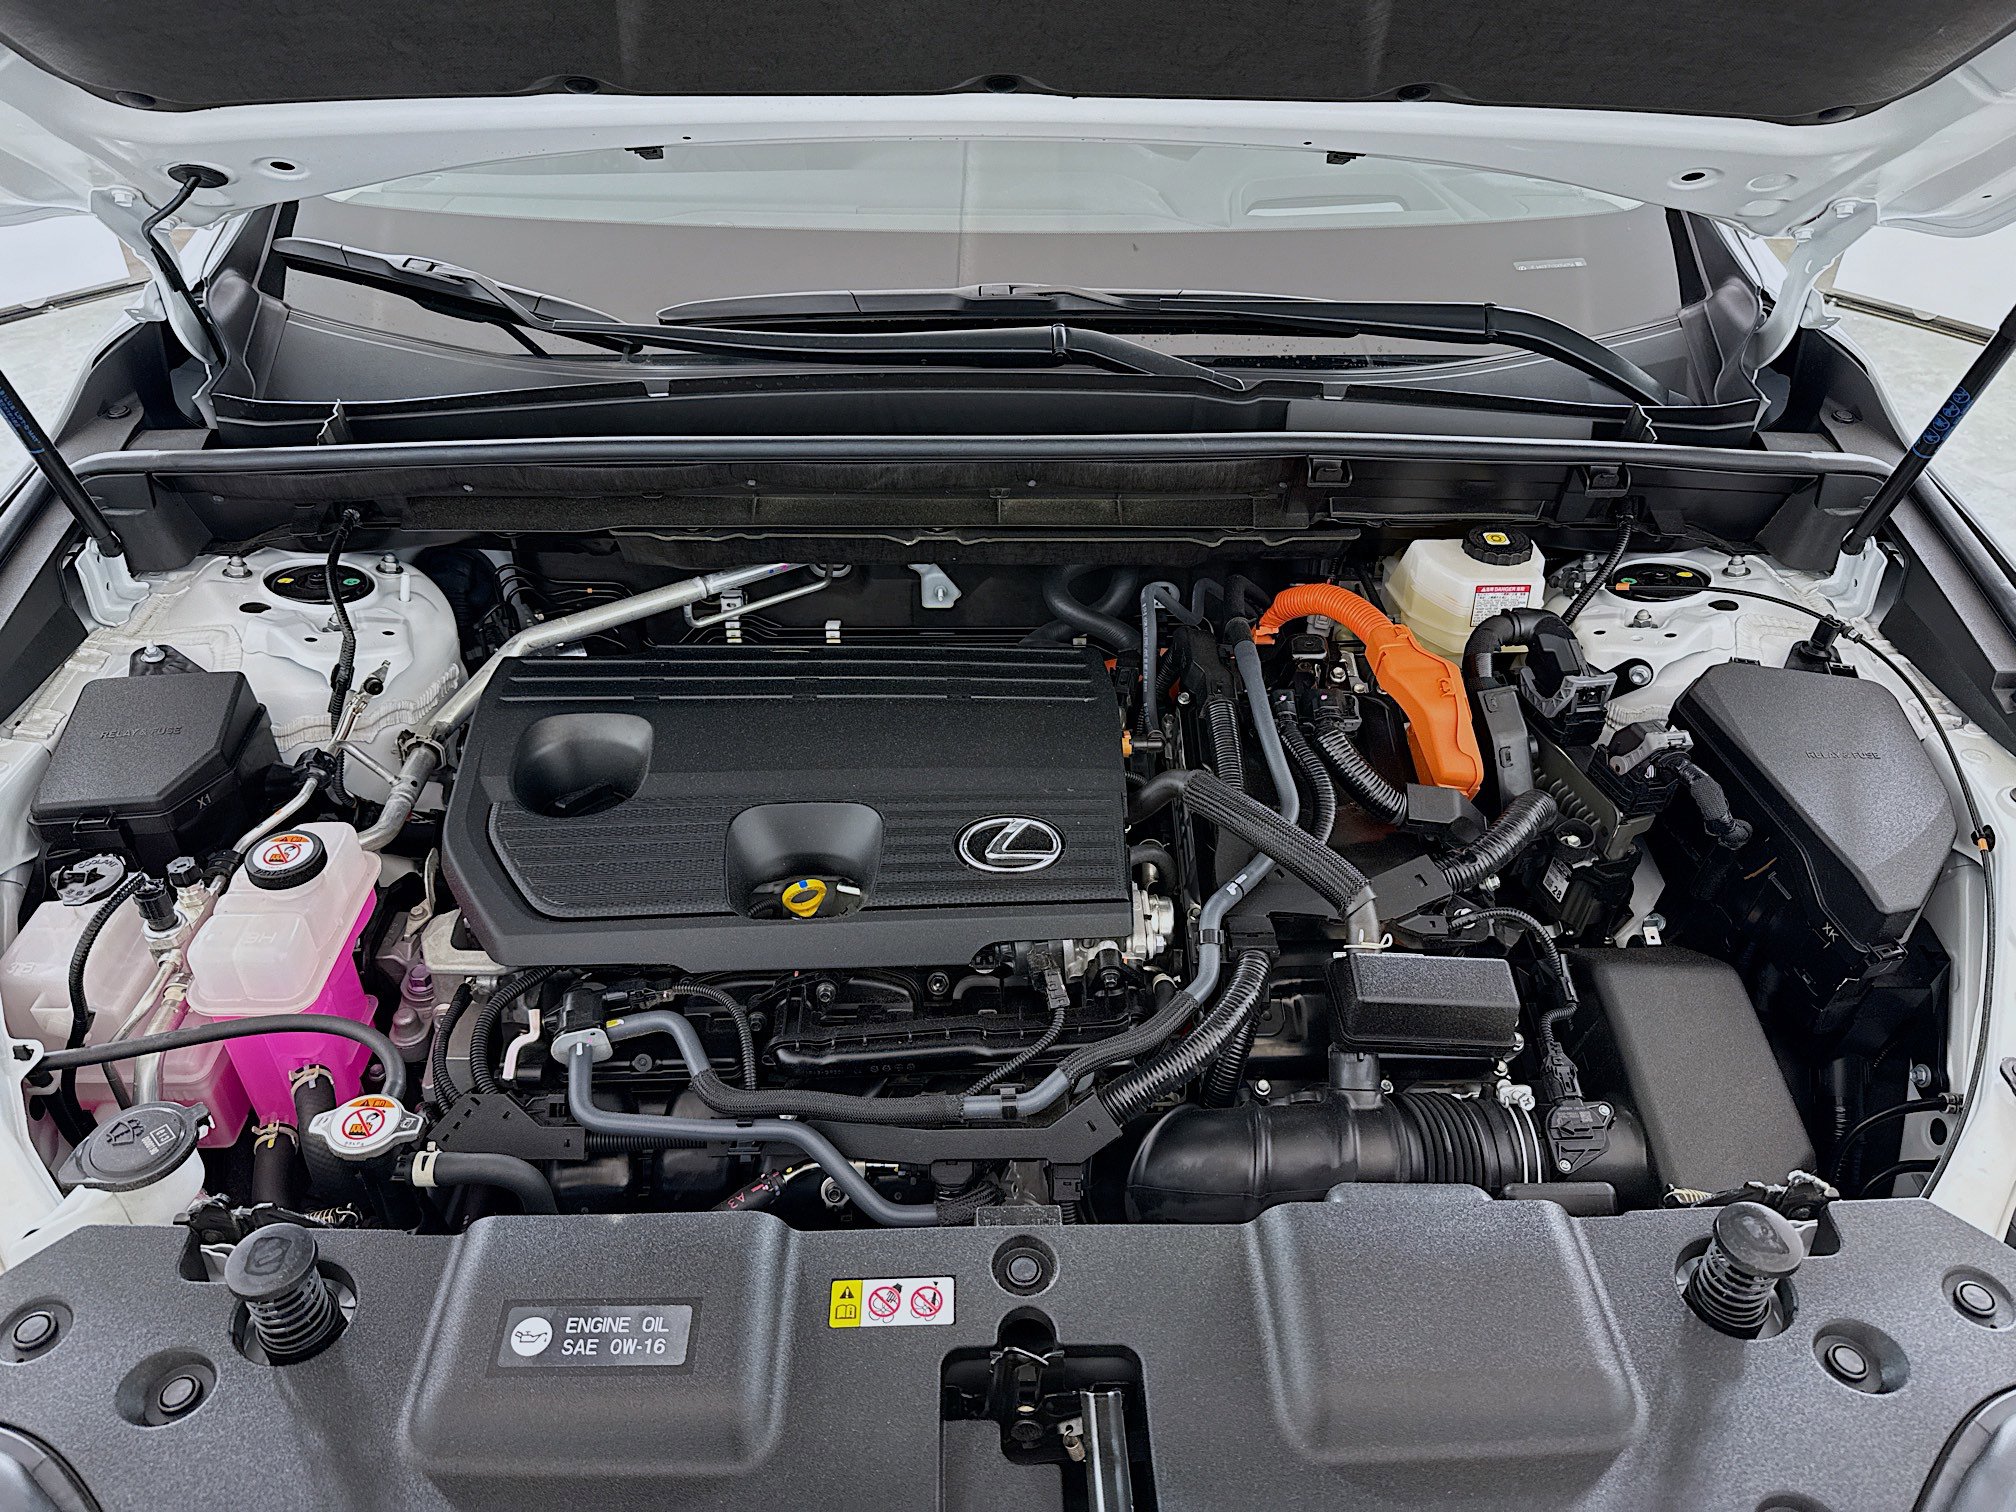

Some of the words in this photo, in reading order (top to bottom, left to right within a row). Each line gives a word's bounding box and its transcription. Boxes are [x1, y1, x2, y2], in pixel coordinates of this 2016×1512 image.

[100, 728, 141, 740] RELAY
[151, 726, 183, 737] FUSE
[1851, 751, 1882, 760] FUSE
[77, 859, 119, 869] COOLANT
[1552, 885, 1562, 900] 28
[727, 1192, 745, 1209] A3
[565, 1317, 631, 1334] ENGINE
[642, 1316, 669, 1333] OIL
[561, 1338, 599, 1356] SAE
[609, 1338, 667, 1355] 0W-16
